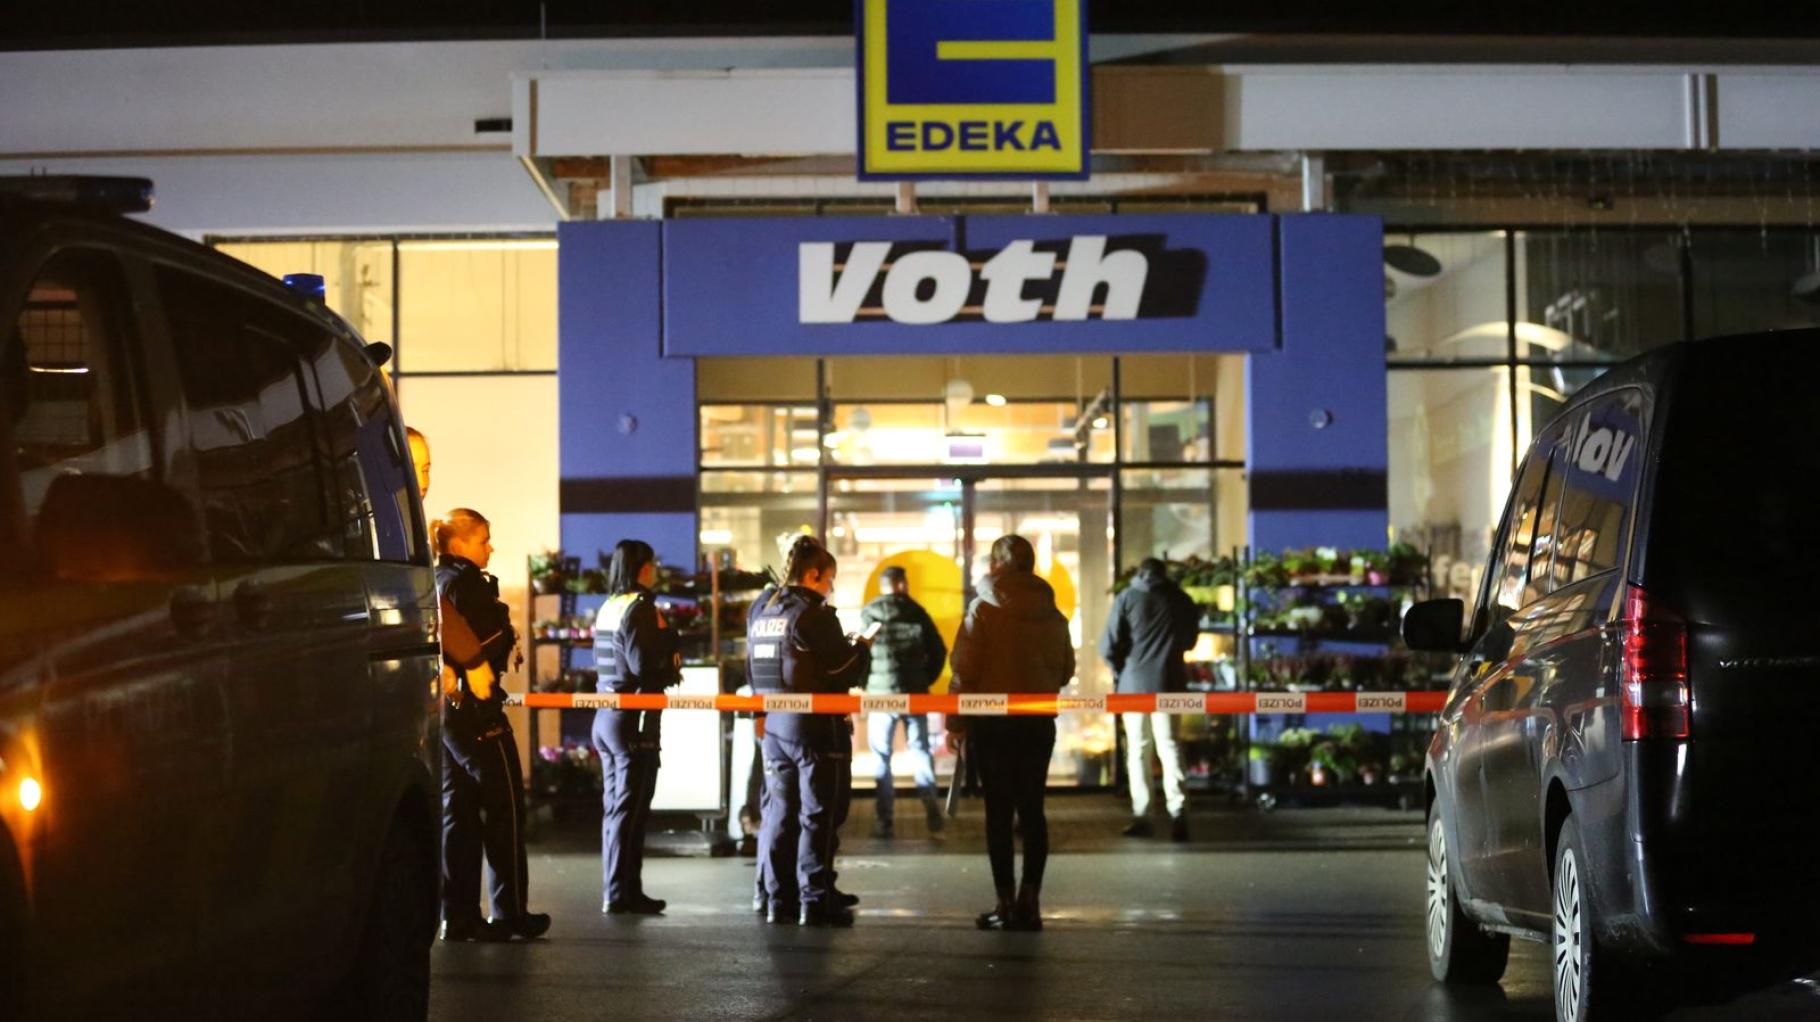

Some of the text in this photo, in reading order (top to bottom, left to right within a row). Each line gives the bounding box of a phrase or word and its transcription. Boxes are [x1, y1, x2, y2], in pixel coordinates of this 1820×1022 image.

[886, 121, 1061, 151] EDEKA
[799, 234, 1149, 325] Voth
[669, 699, 713, 709] POLIZEI
[766, 699, 809, 710] POLIZEI
[863, 699, 907, 709] POLIZEI
[1159, 698, 1203, 709] POLIZEI
[1258, 698, 1303, 709] POLIZEI
[1359, 697, 1403, 708] POLIZEI
